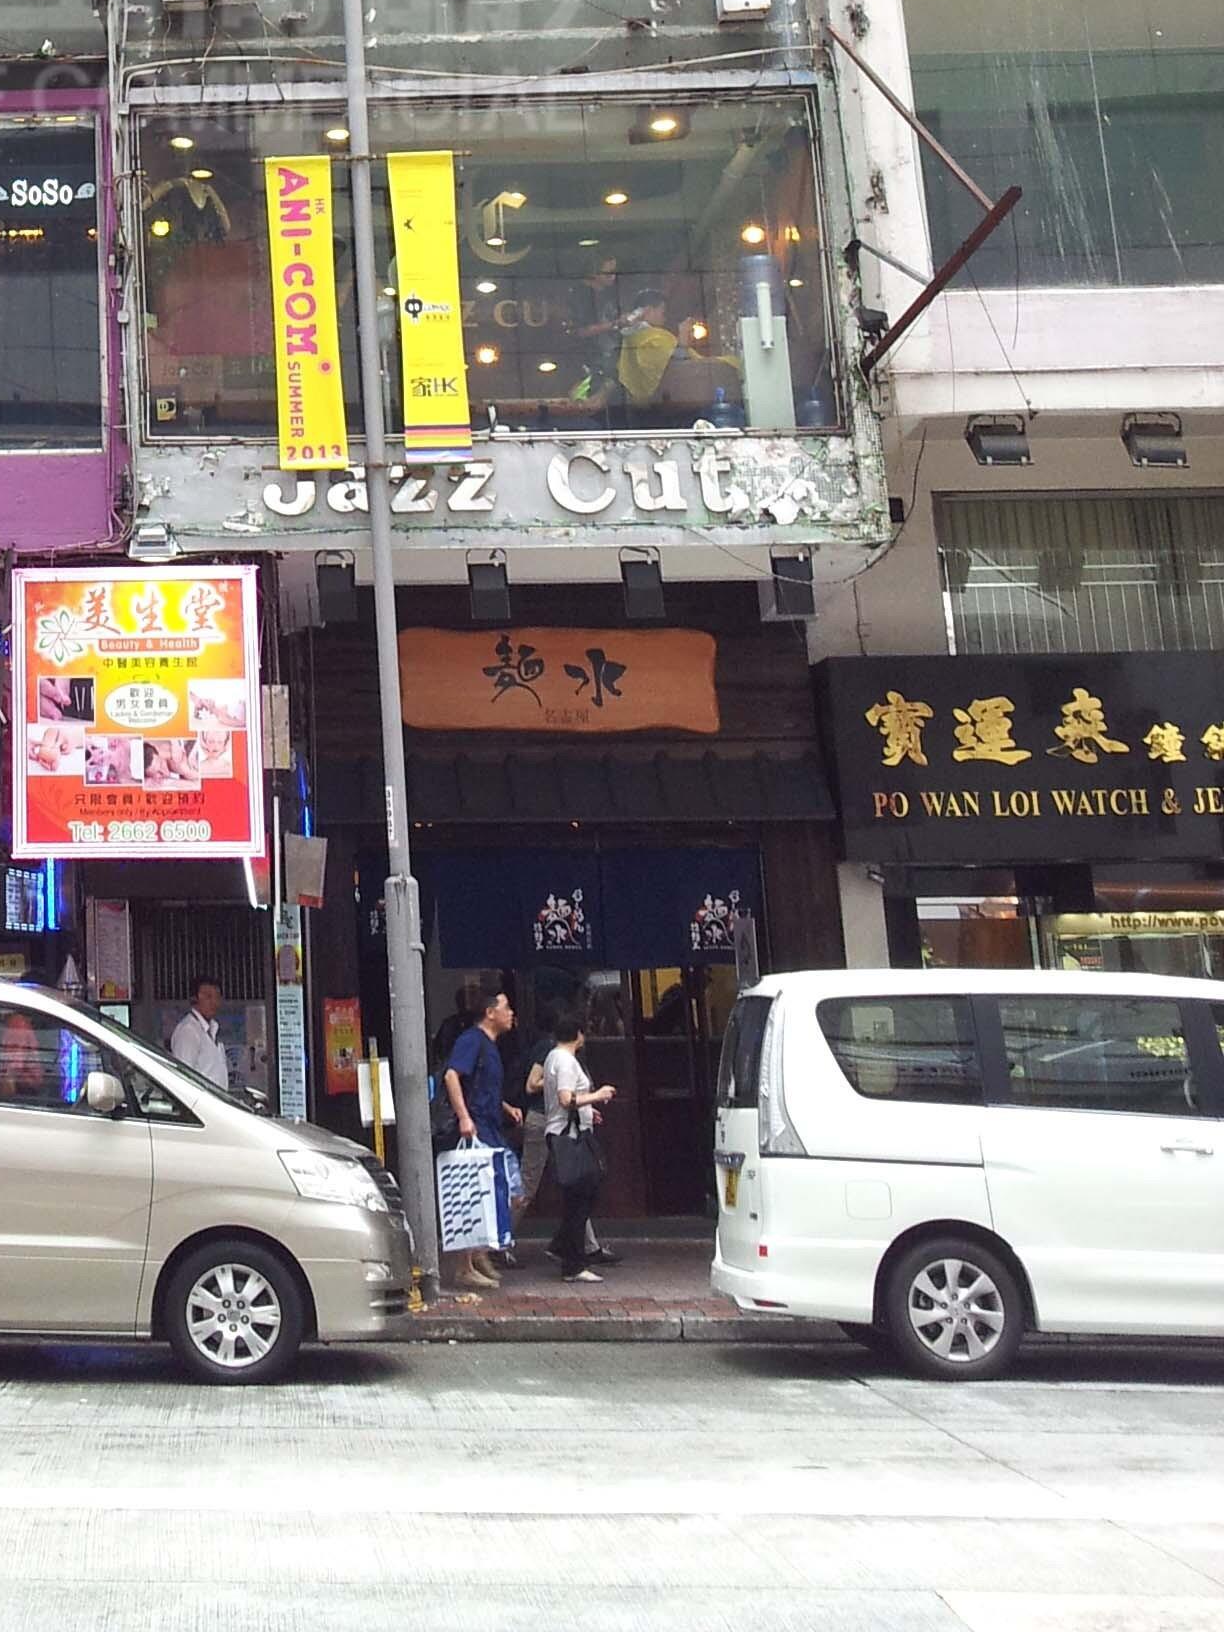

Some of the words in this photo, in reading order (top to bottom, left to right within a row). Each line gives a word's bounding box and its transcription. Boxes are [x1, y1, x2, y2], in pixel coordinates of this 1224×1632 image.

[10, 178, 74, 207] SoSo
[277, 167, 318, 356] ANI-COM
[287, 361, 304, 438] SUMMER
[287, 445, 342, 461] 2013
[545, 448, 738, 514] Cut
[84, 586, 221, 636] 美生堂
[100, 639, 140, 651] Beauty
[145, 639, 154, 650] &
[159, 637, 198, 650] Health
[102, 656, 198, 669] 中醫美容養生館
[872, 792, 909, 818] PO
[920, 791, 980, 818] WAN
[992, 791, 1040, 817] LOI
[1051, 789, 1150, 817] WATCH
[1161, 788, 1182, 816] &
[69, 820, 105, 843] Tel:
[107, 820, 158, 843] 2662
[160, 819, 212, 843] 6500
